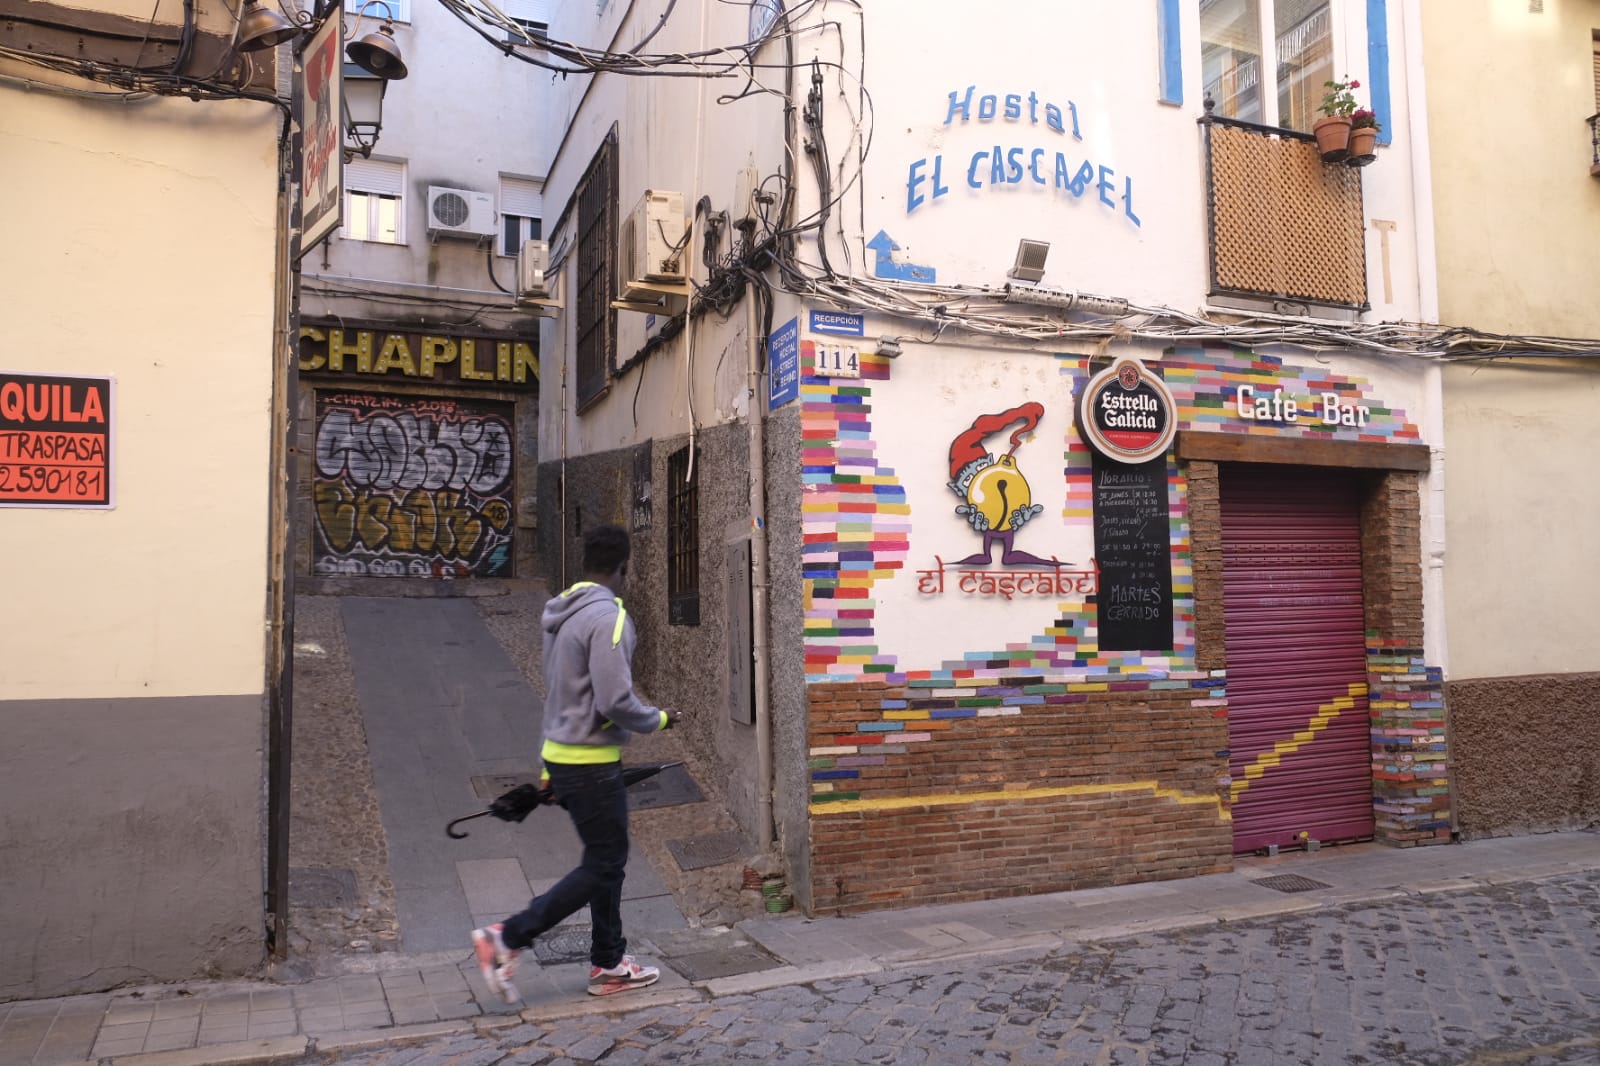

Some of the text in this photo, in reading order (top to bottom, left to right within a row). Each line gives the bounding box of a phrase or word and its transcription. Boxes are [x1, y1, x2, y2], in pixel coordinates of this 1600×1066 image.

[944, 85, 1082, 141] Hostal
[907, 146, 1141, 227] EL CASCABEL
[814, 314, 860, 326] RECEPCION
[819, 350, 859, 371] 114
[0, 381, 105, 424] QUILA
[1101, 391, 1158, 412] Estrella
[1105, 409, 1157, 429] Galicia
[1237, 384, 1297, 422] Café
[1321, 391, 1370, 427] Bar
[916, 555, 945, 594] el
